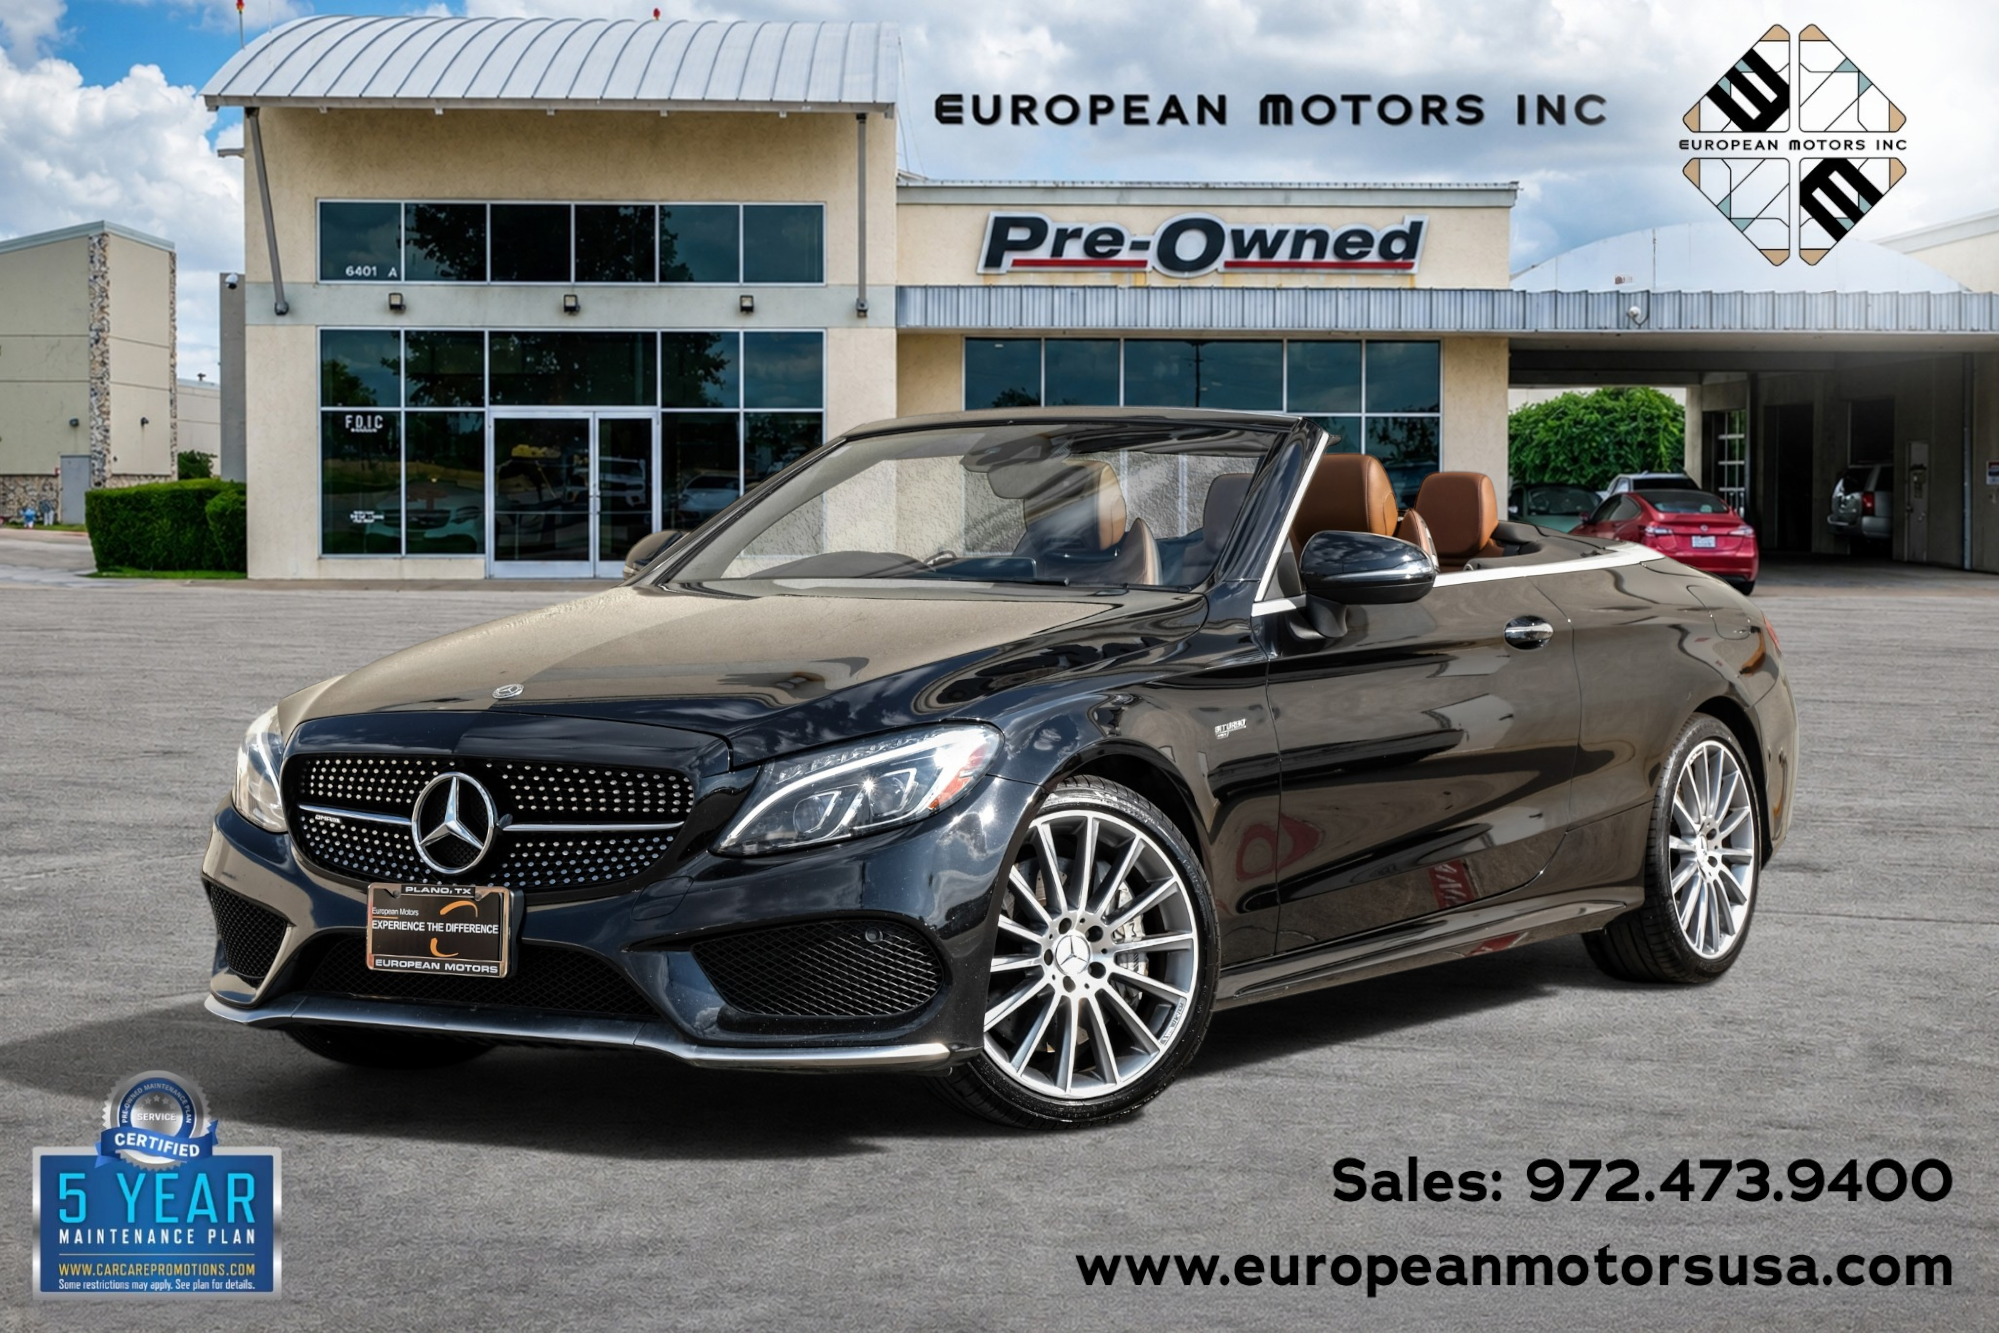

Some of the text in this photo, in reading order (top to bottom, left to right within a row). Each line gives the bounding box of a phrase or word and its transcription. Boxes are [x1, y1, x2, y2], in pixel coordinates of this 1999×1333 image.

[984, 215, 1424, 272] Pre-Owned
[345, 265, 398, 278] 6401 A
[372, 907, 419, 917] European Motors
[372, 920, 499, 935] EXPERIENCE THE DIFFERENCE
[375, 959, 499, 974] EUROPEAN MOTORS
